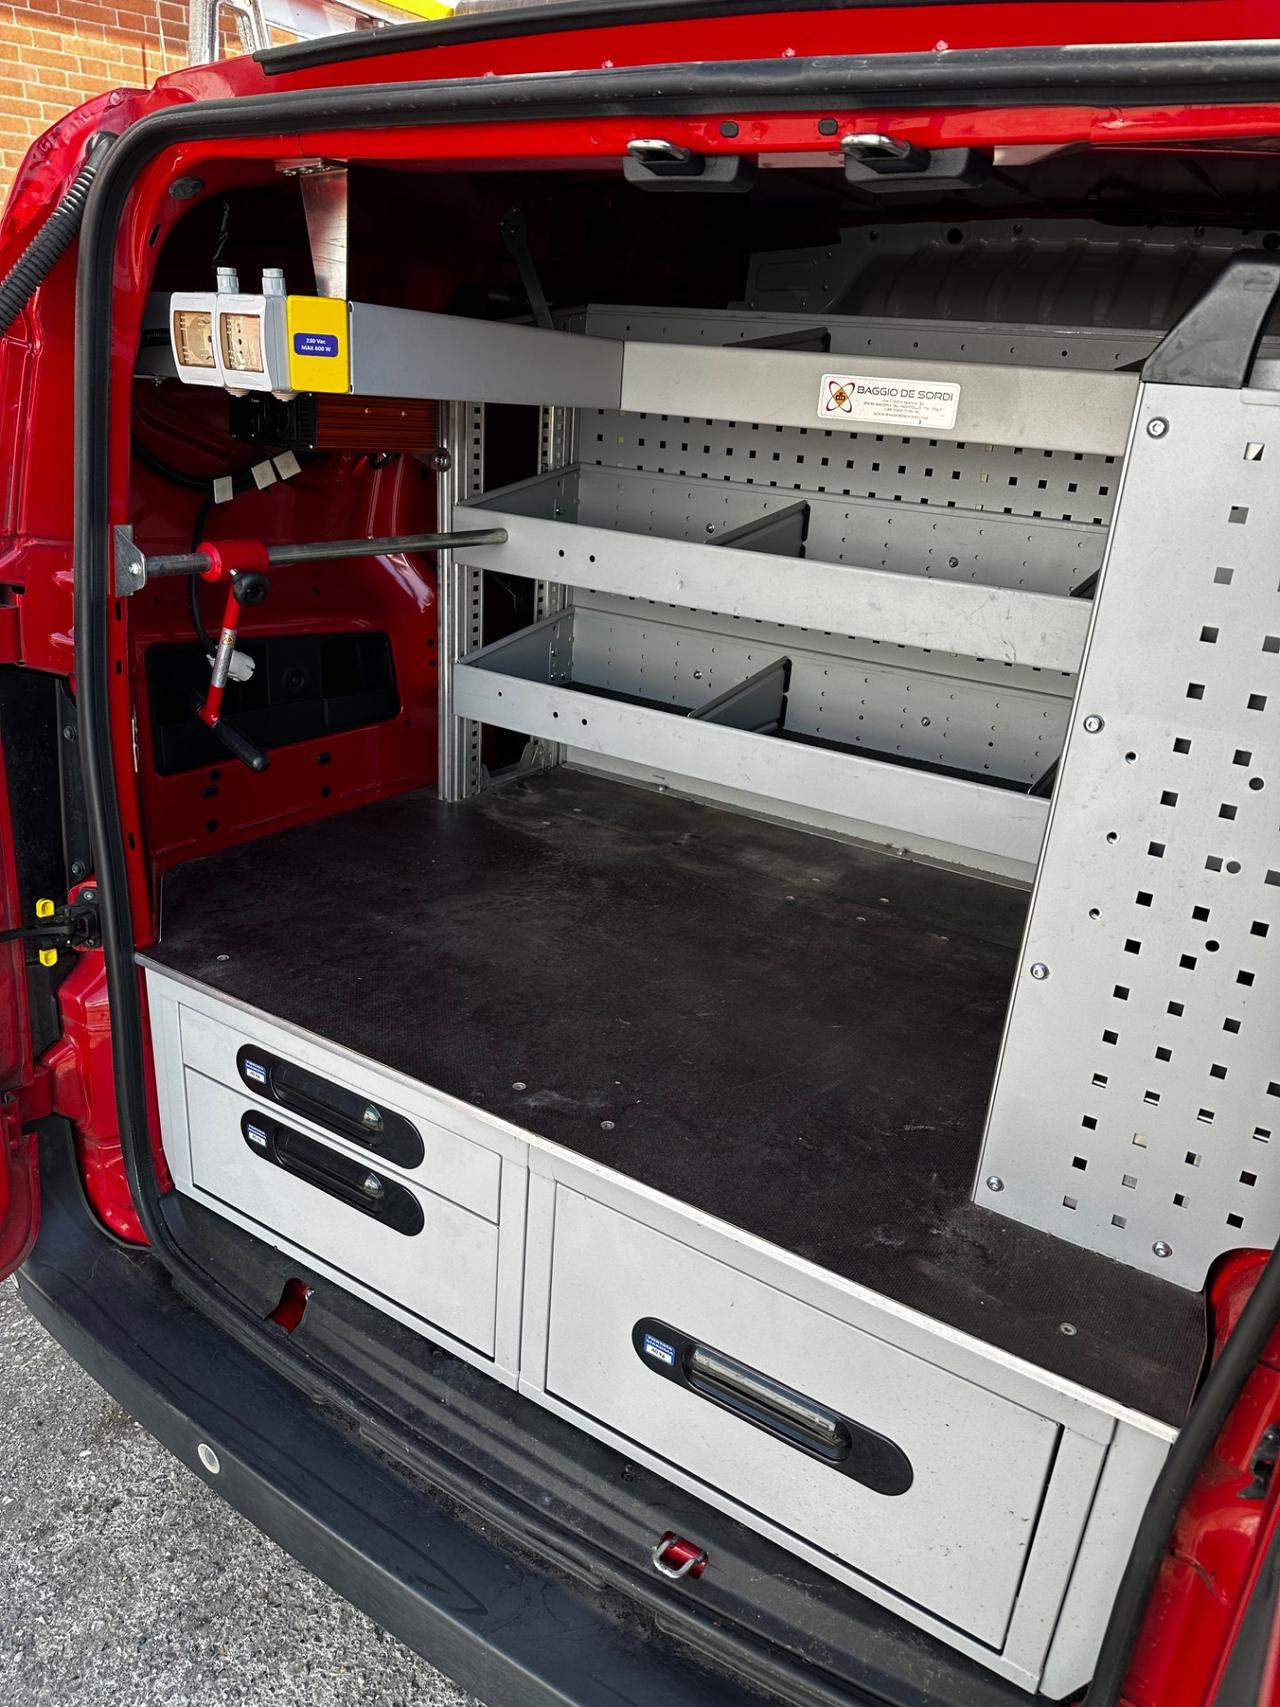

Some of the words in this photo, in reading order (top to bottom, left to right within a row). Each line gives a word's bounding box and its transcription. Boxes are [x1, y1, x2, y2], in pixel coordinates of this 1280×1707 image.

[857, 386, 898, 397] BAGGIO
[900, 389, 915, 399] DE
[917, 391, 954, 401] SORDI
